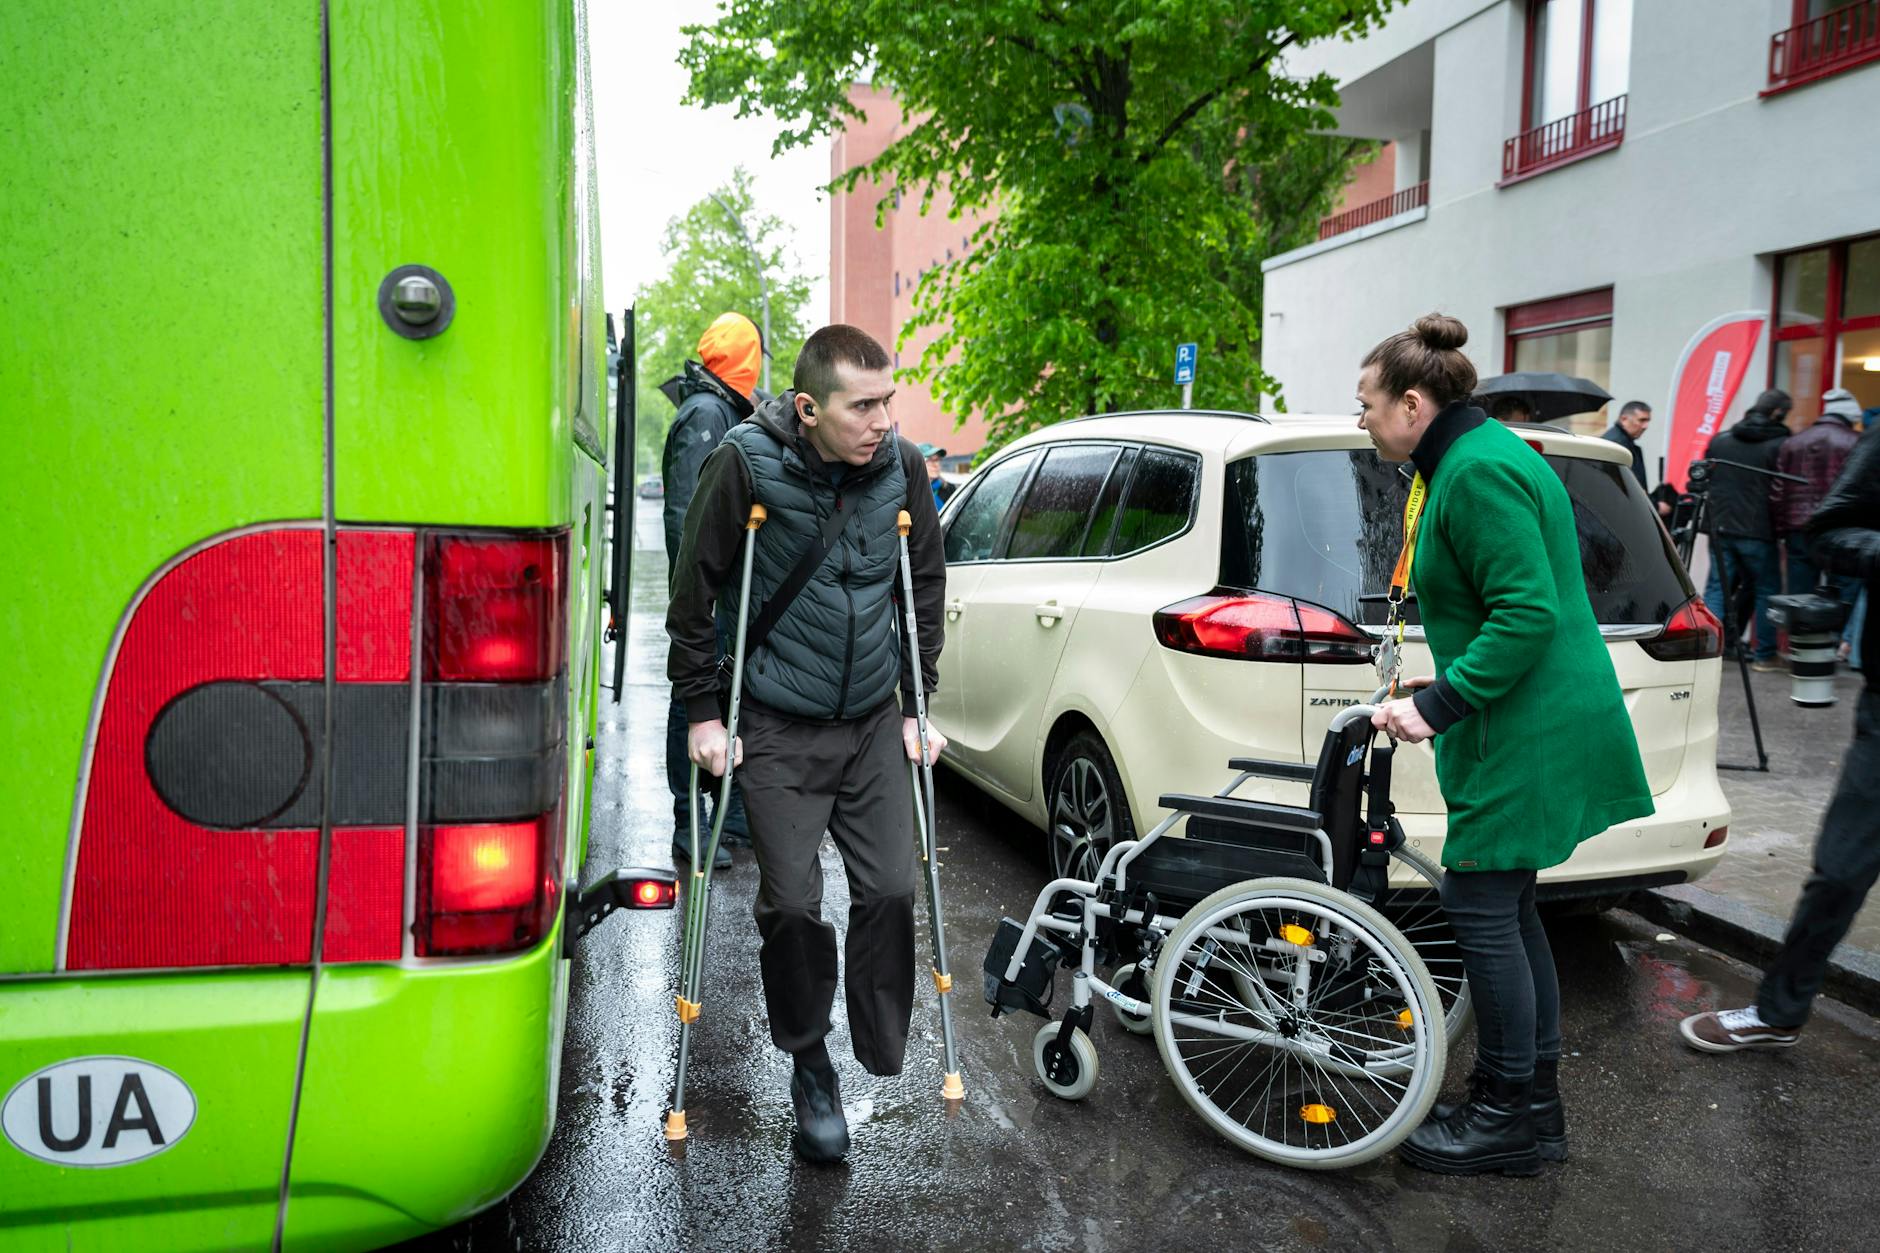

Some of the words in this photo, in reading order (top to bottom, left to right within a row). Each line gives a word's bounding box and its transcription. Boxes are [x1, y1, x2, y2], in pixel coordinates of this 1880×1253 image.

[1179, 347, 1189, 362] P
[1408, 484, 1424, 520] BRIDGE
[1310, 697, 1360, 707] ZAFIRA
[37, 1072, 166, 1152] UA
